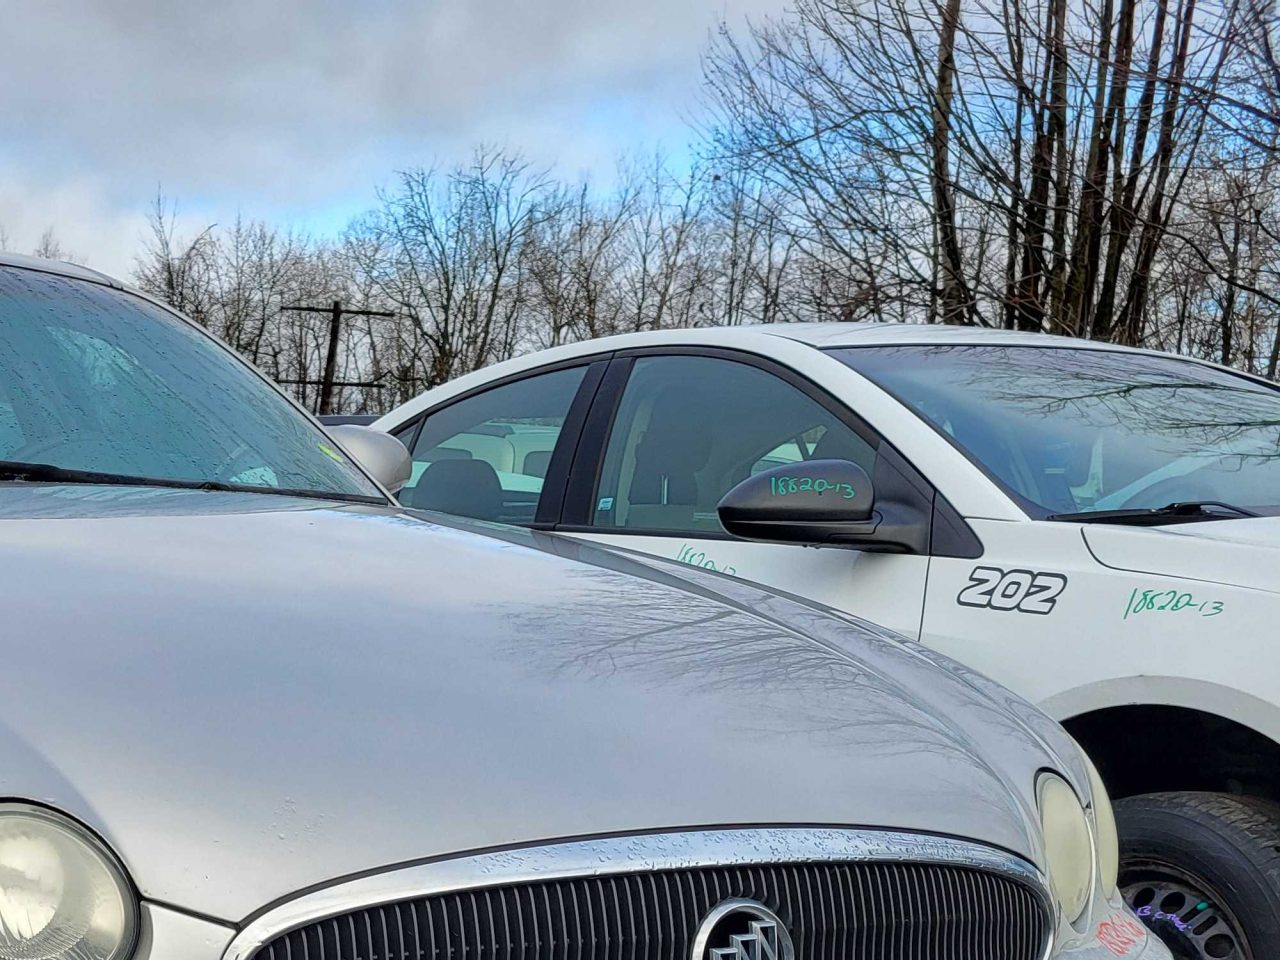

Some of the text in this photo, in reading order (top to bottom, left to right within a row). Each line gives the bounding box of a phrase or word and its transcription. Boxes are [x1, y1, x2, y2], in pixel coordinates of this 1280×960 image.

[771, 476, 855, 499] 18820-13
[956, 566, 1068, 615] 202
[1123, 588, 1224, 620] 18820-13
